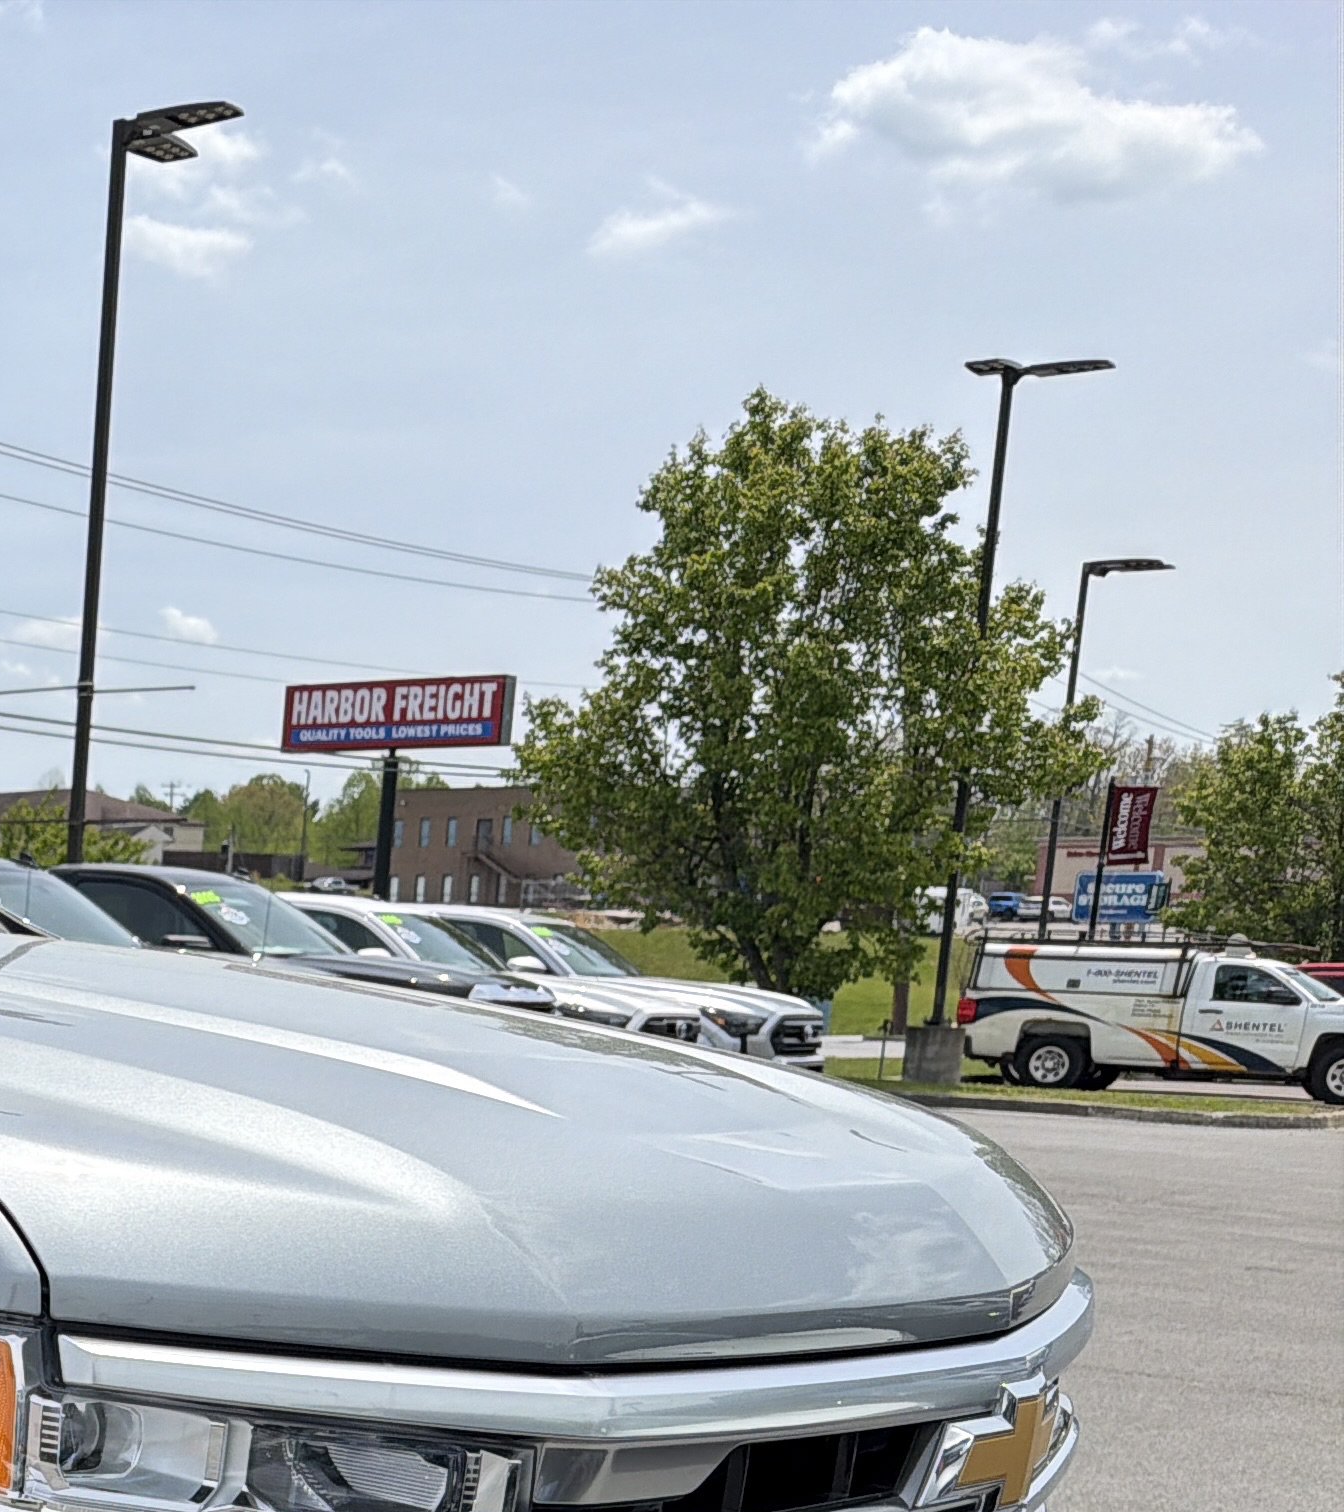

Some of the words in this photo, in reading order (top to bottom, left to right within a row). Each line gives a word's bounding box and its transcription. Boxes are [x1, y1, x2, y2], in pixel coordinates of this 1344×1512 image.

[291, 686, 387, 725] HARBOR
[393, 683, 498, 722] FREIGHT
[299, 728, 349, 742] QUALITY
[350, 727, 386, 740] TOOLS
[391, 725, 439, 739] LOWEST
[440, 723, 483, 737] PRICES
[1112, 792, 1134, 850] Welcome
[1225, 1021, 1285, 1033] SHENTEL
